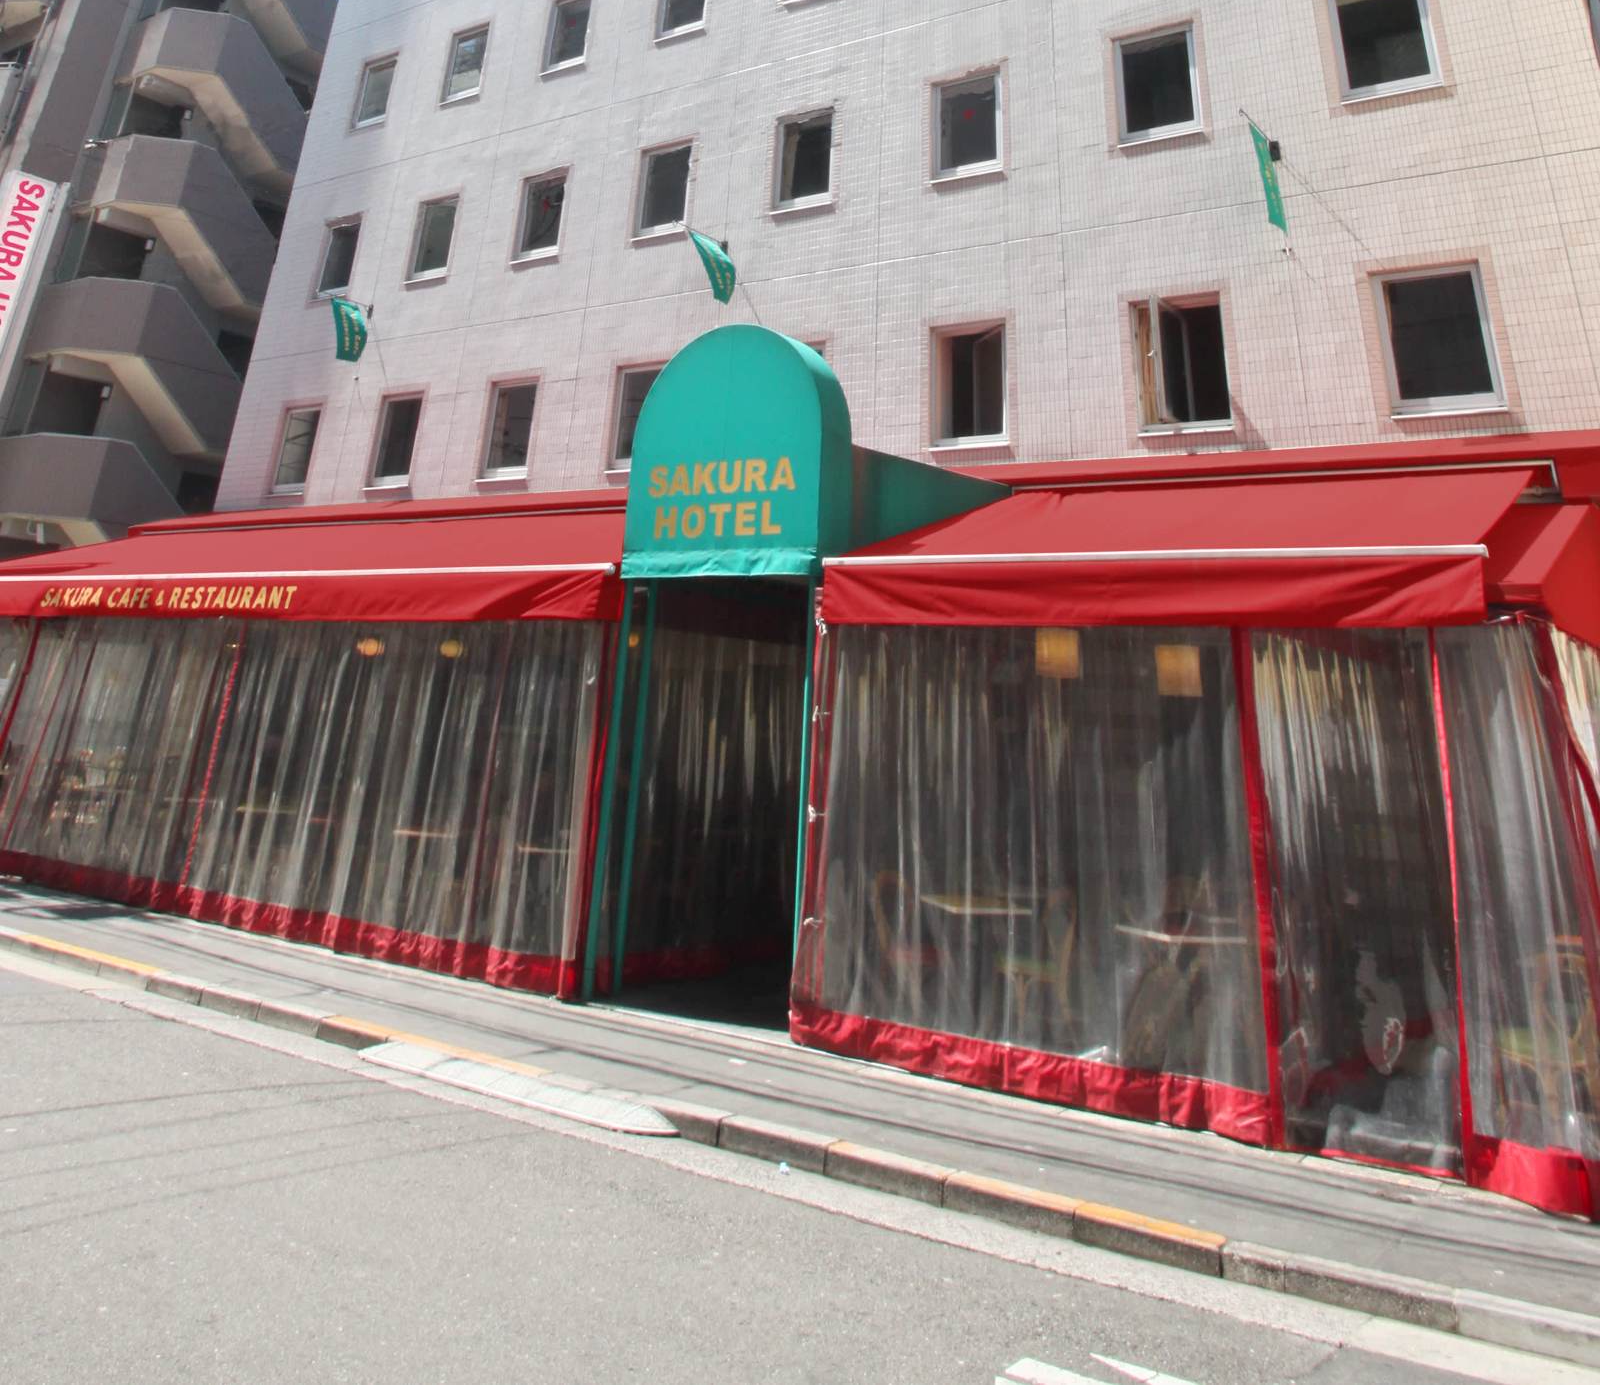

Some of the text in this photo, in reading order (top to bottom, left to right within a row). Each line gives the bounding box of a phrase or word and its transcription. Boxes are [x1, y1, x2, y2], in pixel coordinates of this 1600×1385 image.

[649, 456, 796, 497] SAKURA
[654, 500, 782, 539] HOTEL
[40, 587, 103, 607] SAKURA
[107, 587, 152, 608] CAFE
[168, 586, 298, 609] RESTAURANT
